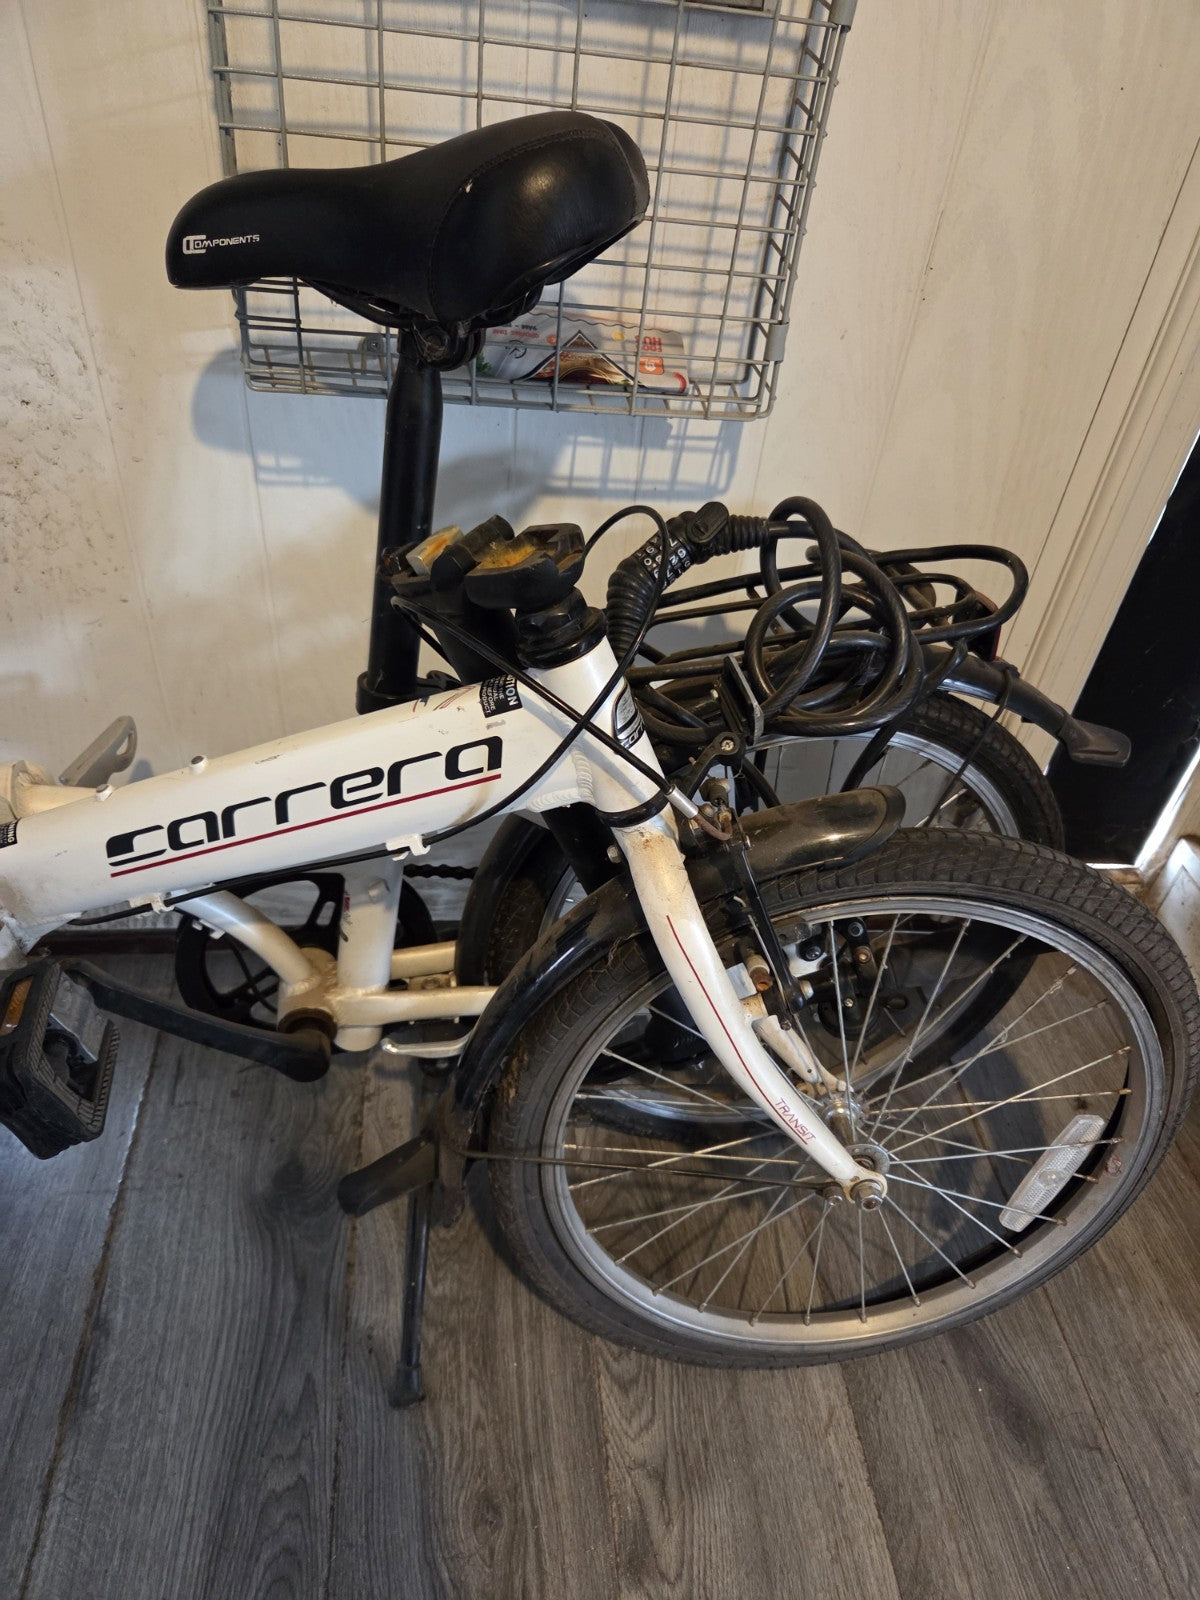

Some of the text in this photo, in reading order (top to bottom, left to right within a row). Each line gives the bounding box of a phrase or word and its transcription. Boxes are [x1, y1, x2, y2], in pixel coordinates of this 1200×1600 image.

[182, 234, 260, 255] COMPONENTS
[106, 735, 503, 867] carrera
[775, 1096, 817, 1141] TRANSIT
